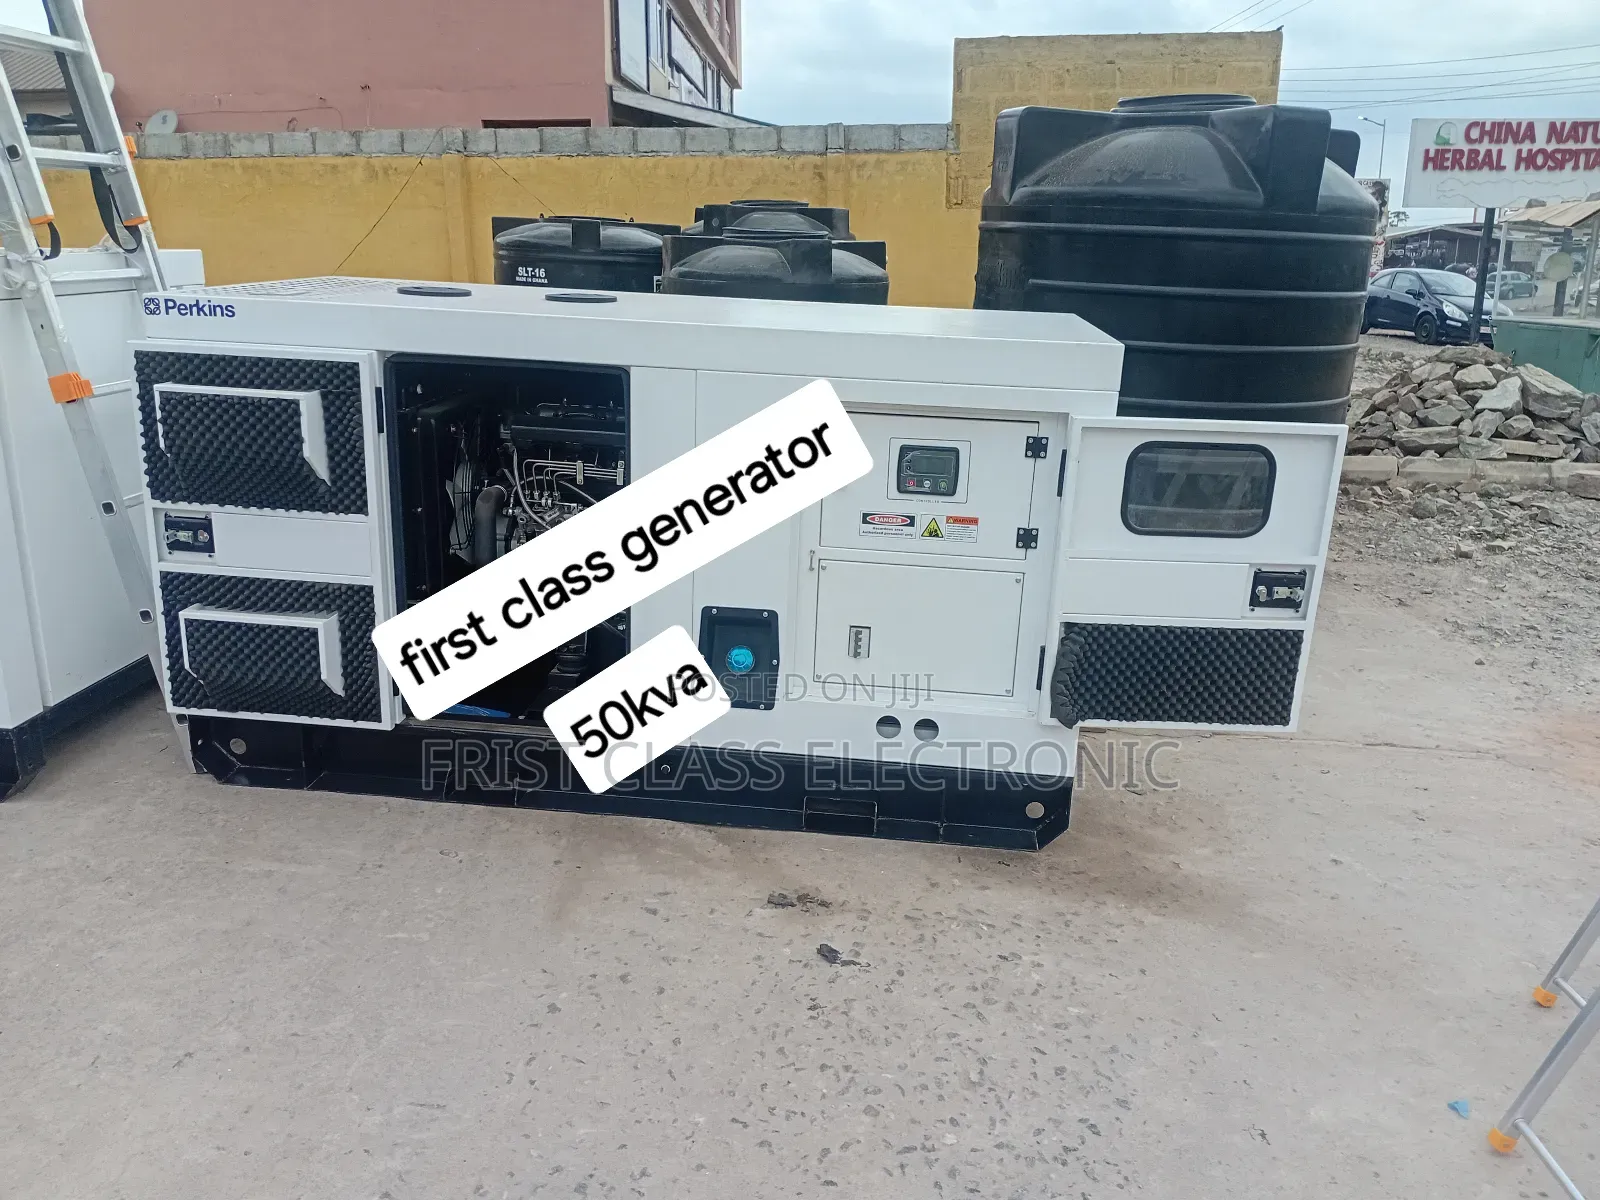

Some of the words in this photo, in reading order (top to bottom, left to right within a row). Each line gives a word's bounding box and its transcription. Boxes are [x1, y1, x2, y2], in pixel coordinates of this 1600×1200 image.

[1464, 120, 1537, 145] CHINA
[1422, 148, 1507, 172] HERBAL
[518, 266, 545, 277] SLT-16
[164, 298, 236, 318] Perkins
